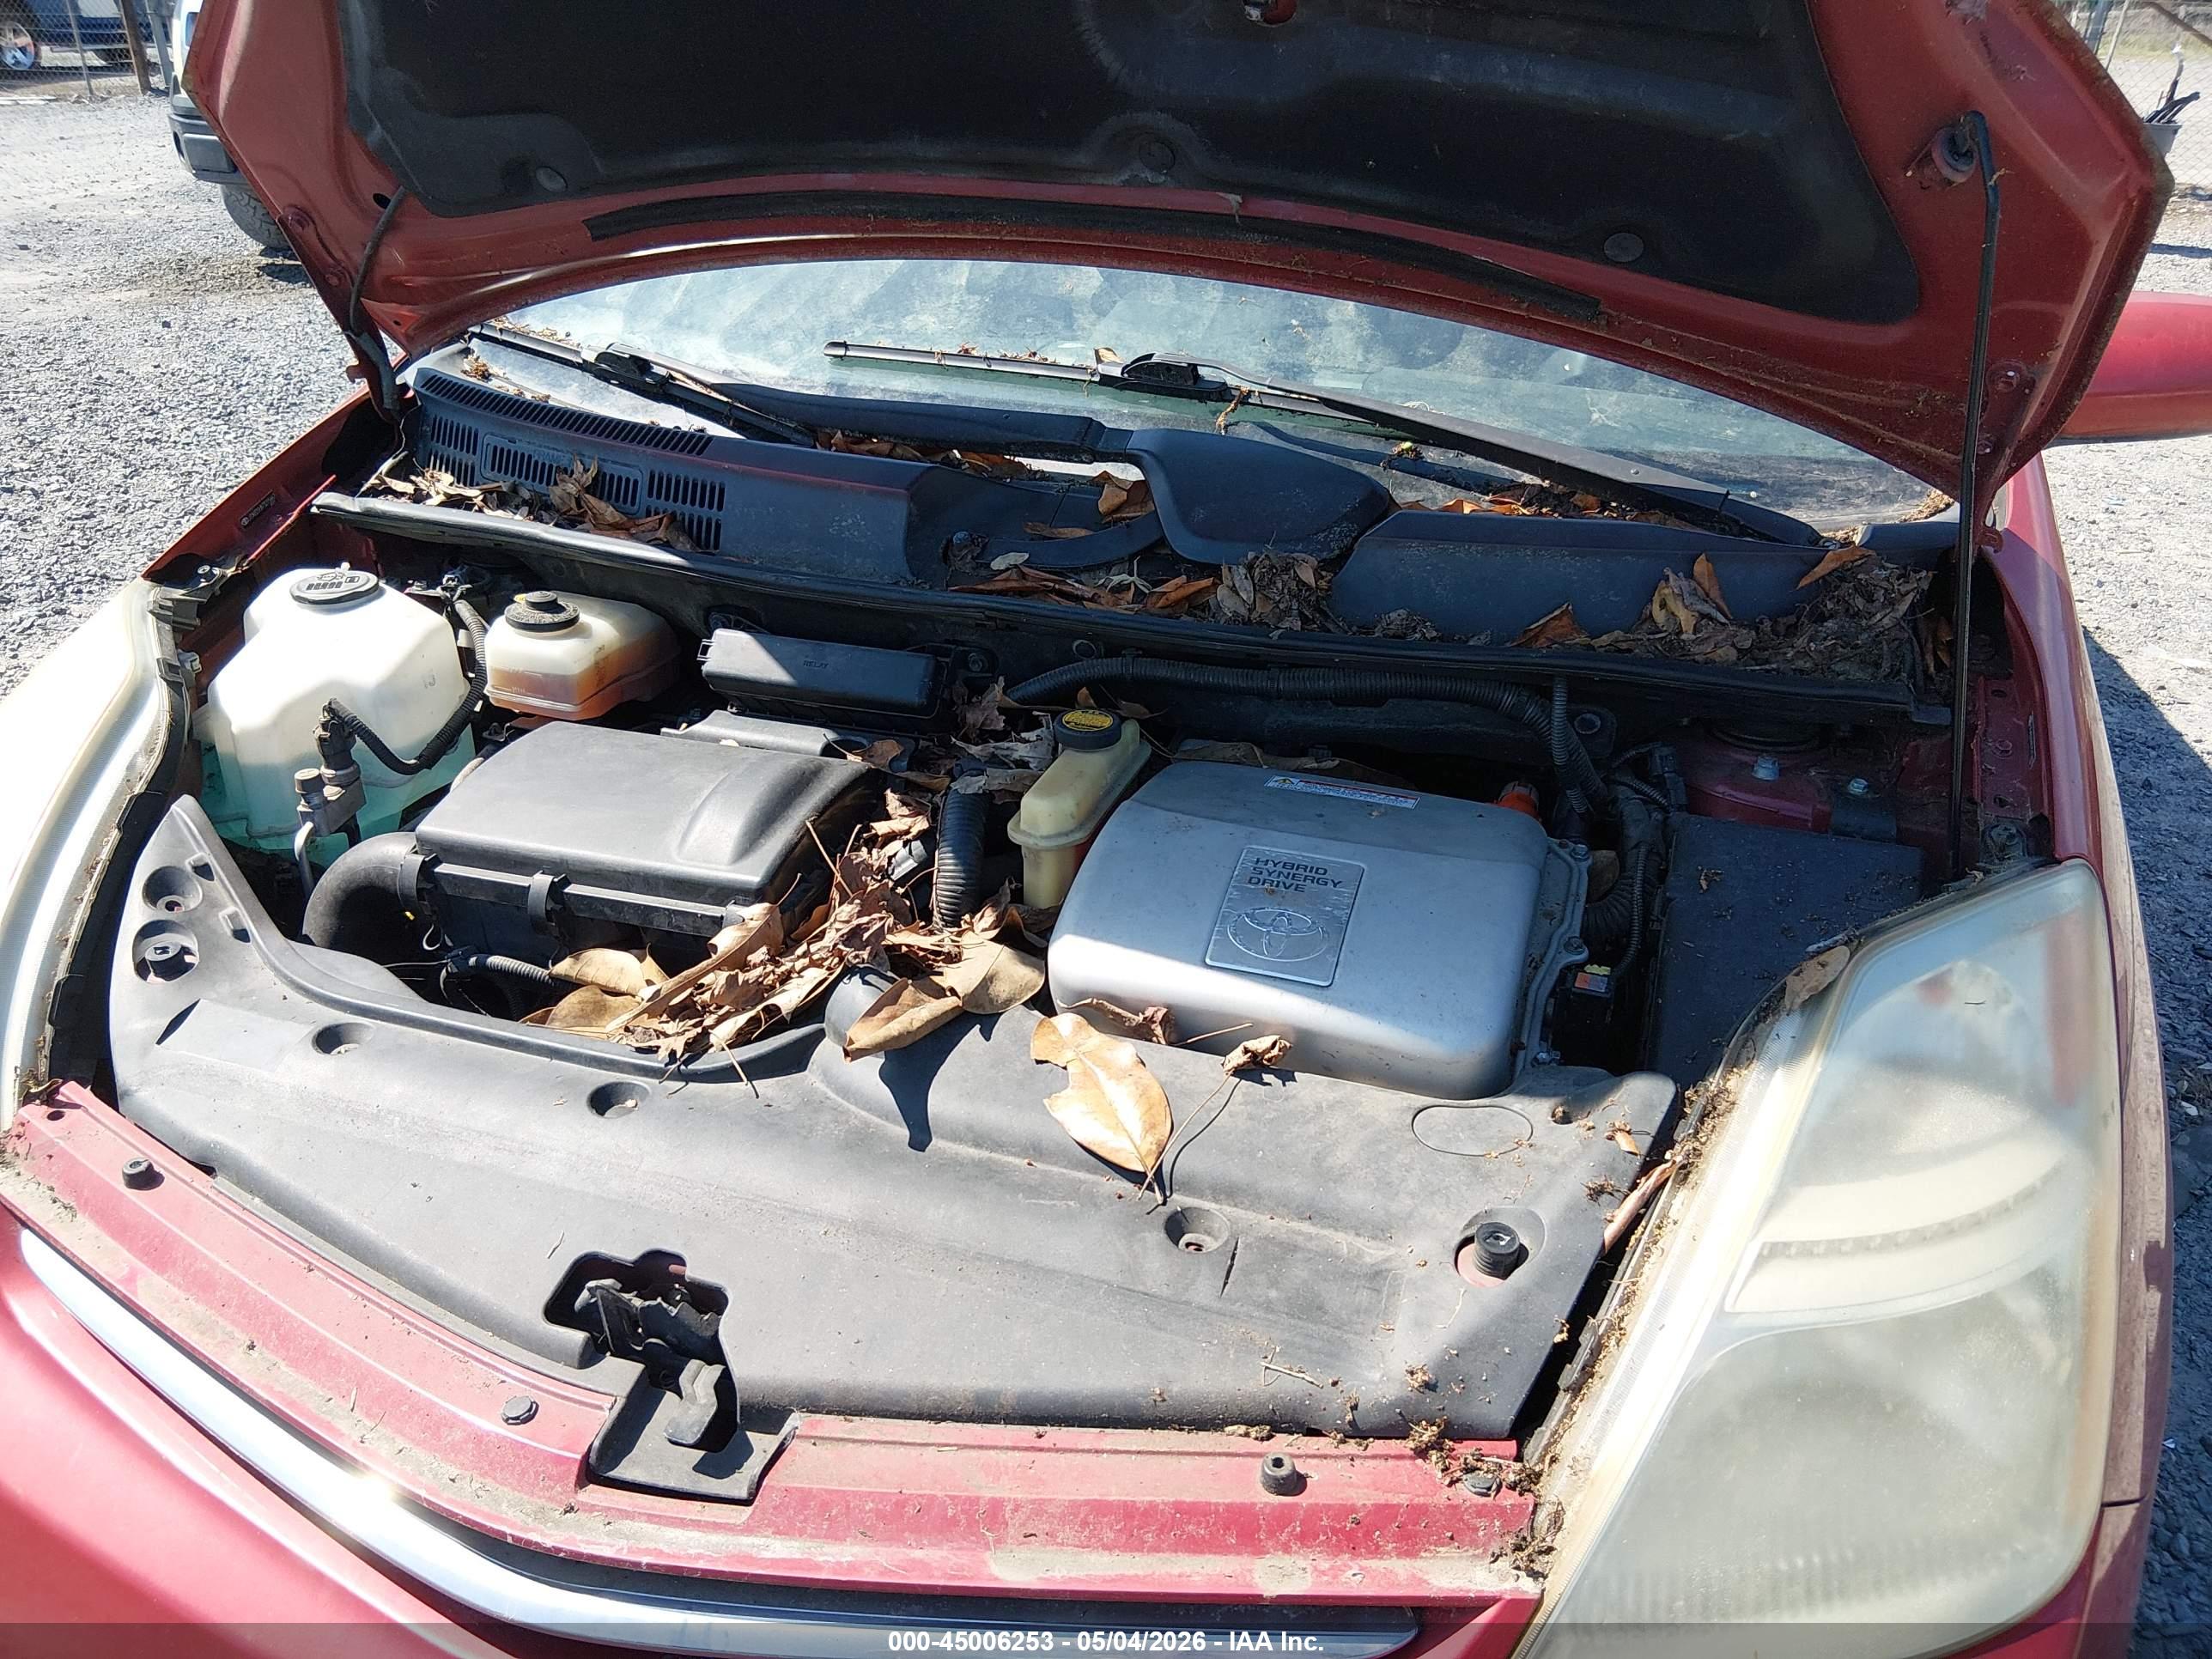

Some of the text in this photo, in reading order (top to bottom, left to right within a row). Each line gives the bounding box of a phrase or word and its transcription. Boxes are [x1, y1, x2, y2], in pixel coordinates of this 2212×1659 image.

[803, 659, 830, 669] RELAY
[1255, 857, 1328, 876] HYBRID
[1248, 876, 1307, 892] DRIVE
[1250, 866, 1343, 888] SYNERGY
